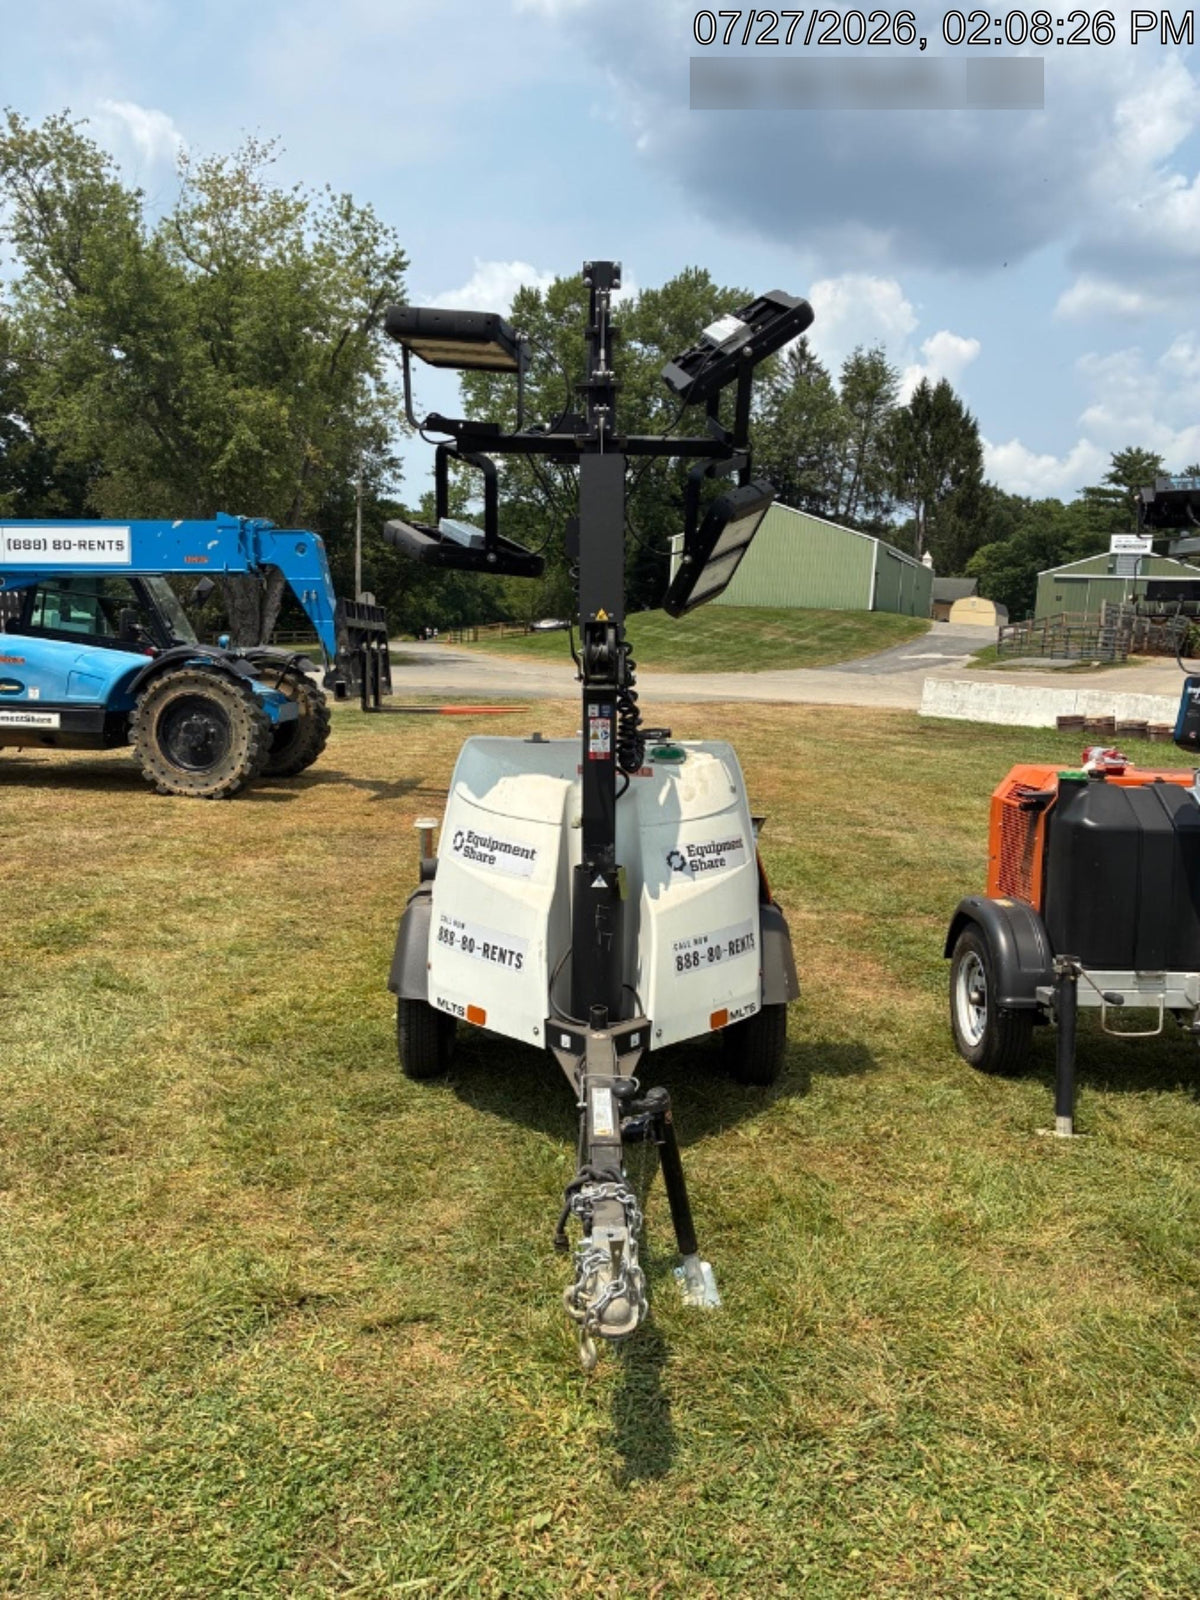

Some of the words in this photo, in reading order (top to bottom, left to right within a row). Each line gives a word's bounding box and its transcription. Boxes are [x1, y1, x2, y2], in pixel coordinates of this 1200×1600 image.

[7, 538, 48, 552] (888)
[52, 539, 125, 551] 80-RENTS
[466, 830, 537, 860] Equipment
[686, 838, 744, 857] Equipment
[463, 846, 497, 865] Share
[689, 857, 727, 872] Share
[438, 925, 523, 970] 888-80-RENTS
[676, 932, 755, 972] 888-80-RENTS
